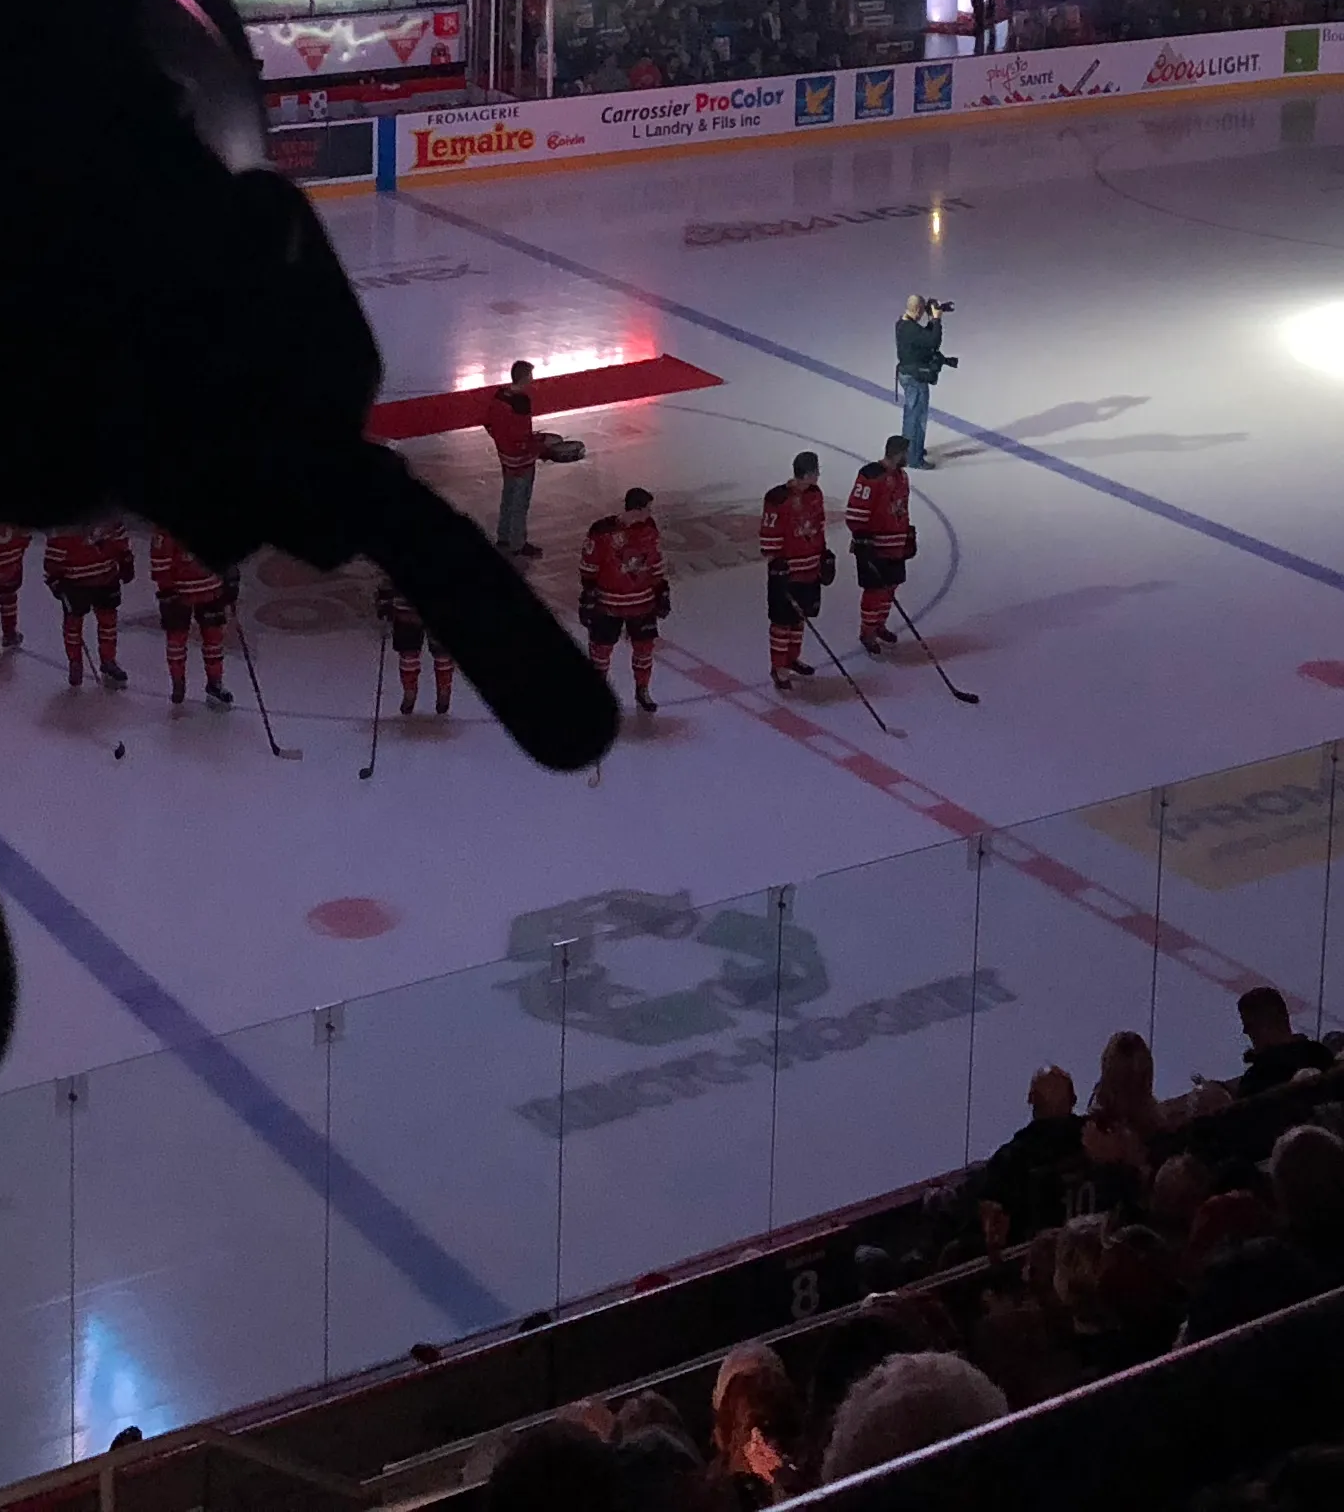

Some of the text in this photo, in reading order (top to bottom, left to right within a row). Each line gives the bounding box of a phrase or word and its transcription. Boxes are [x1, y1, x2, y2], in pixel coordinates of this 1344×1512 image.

[1146, 53, 1207, 85] Coors
[427, 105, 521, 125] FROMAGERIE
[600, 87, 785, 125] Carrossier ProColor
[632, 124, 642, 140] L
[645, 120, 694, 140] Landry
[698, 117, 708, 132] &
[712, 116, 737, 131] Fils
[410, 122, 535, 170] Lemaire
[790, 1269, 820, 1319] 8
